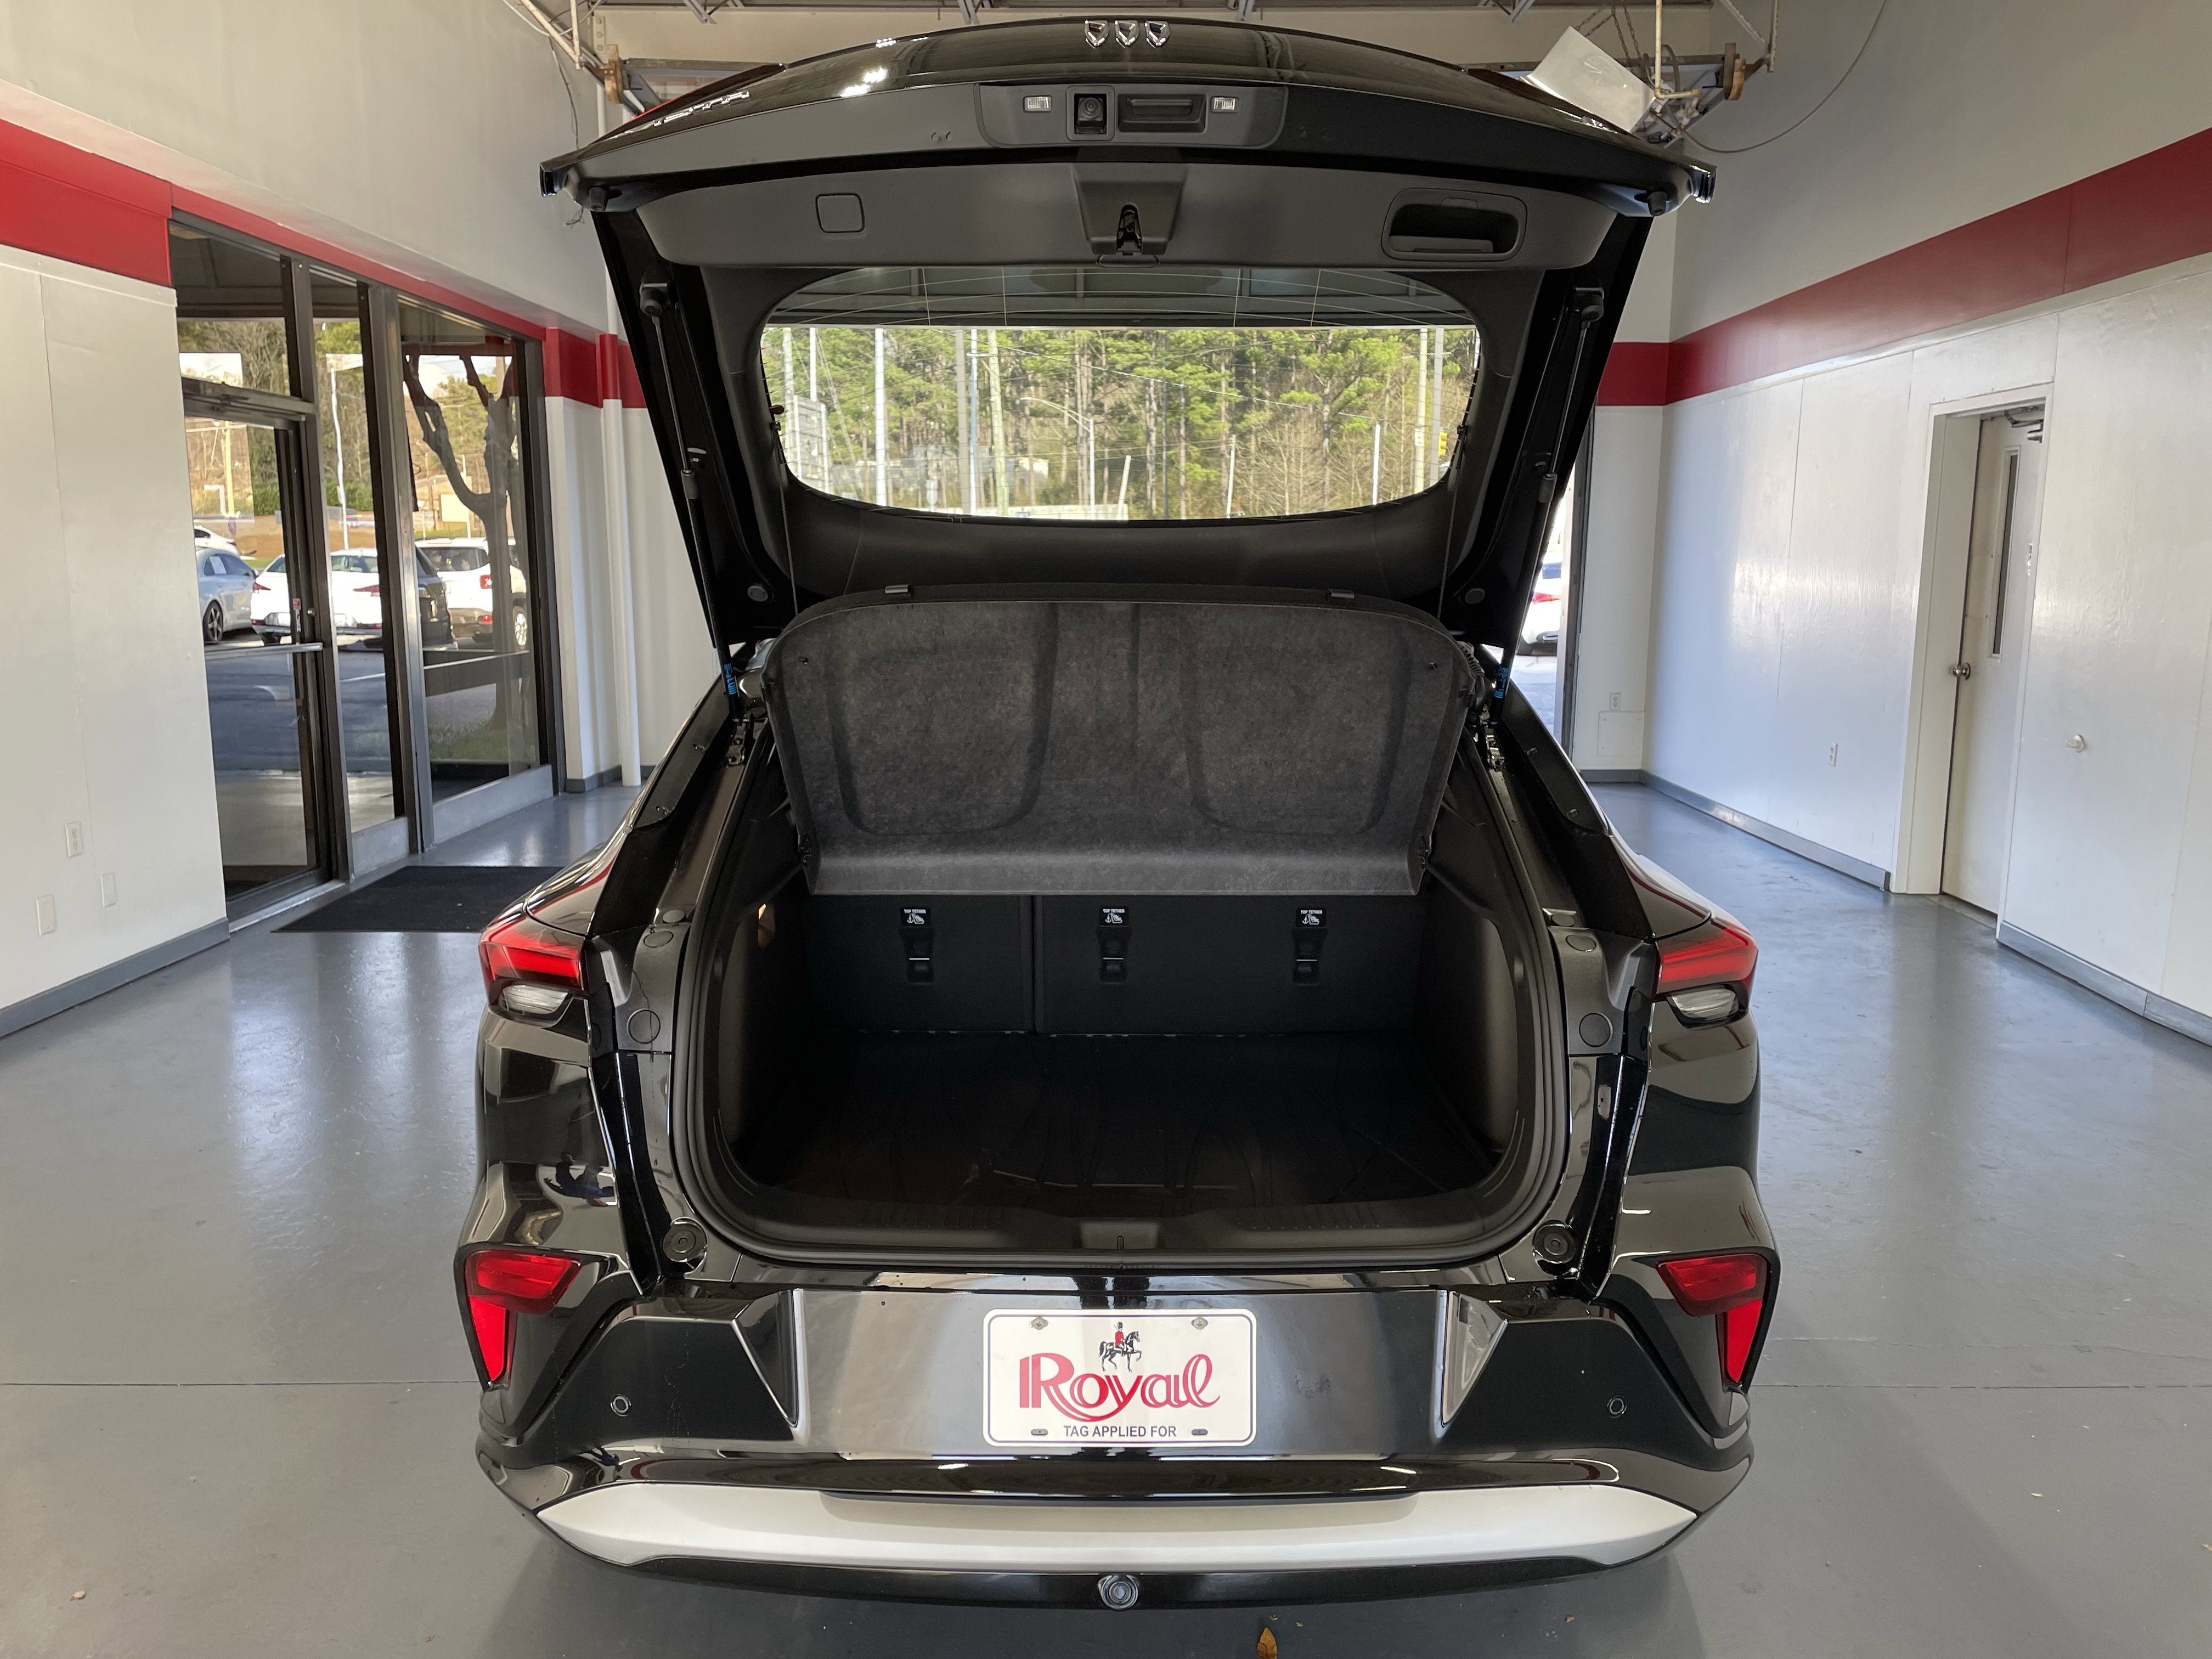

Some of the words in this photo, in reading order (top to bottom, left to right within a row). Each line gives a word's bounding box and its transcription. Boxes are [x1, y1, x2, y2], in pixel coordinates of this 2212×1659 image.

[1019, 1352, 1220, 1422] Royal
[1064, 1425, 1088, 1437] TAG
[1092, 1425, 1146, 1437] APPLIED
[1150, 1425, 1177, 1437] FOR
